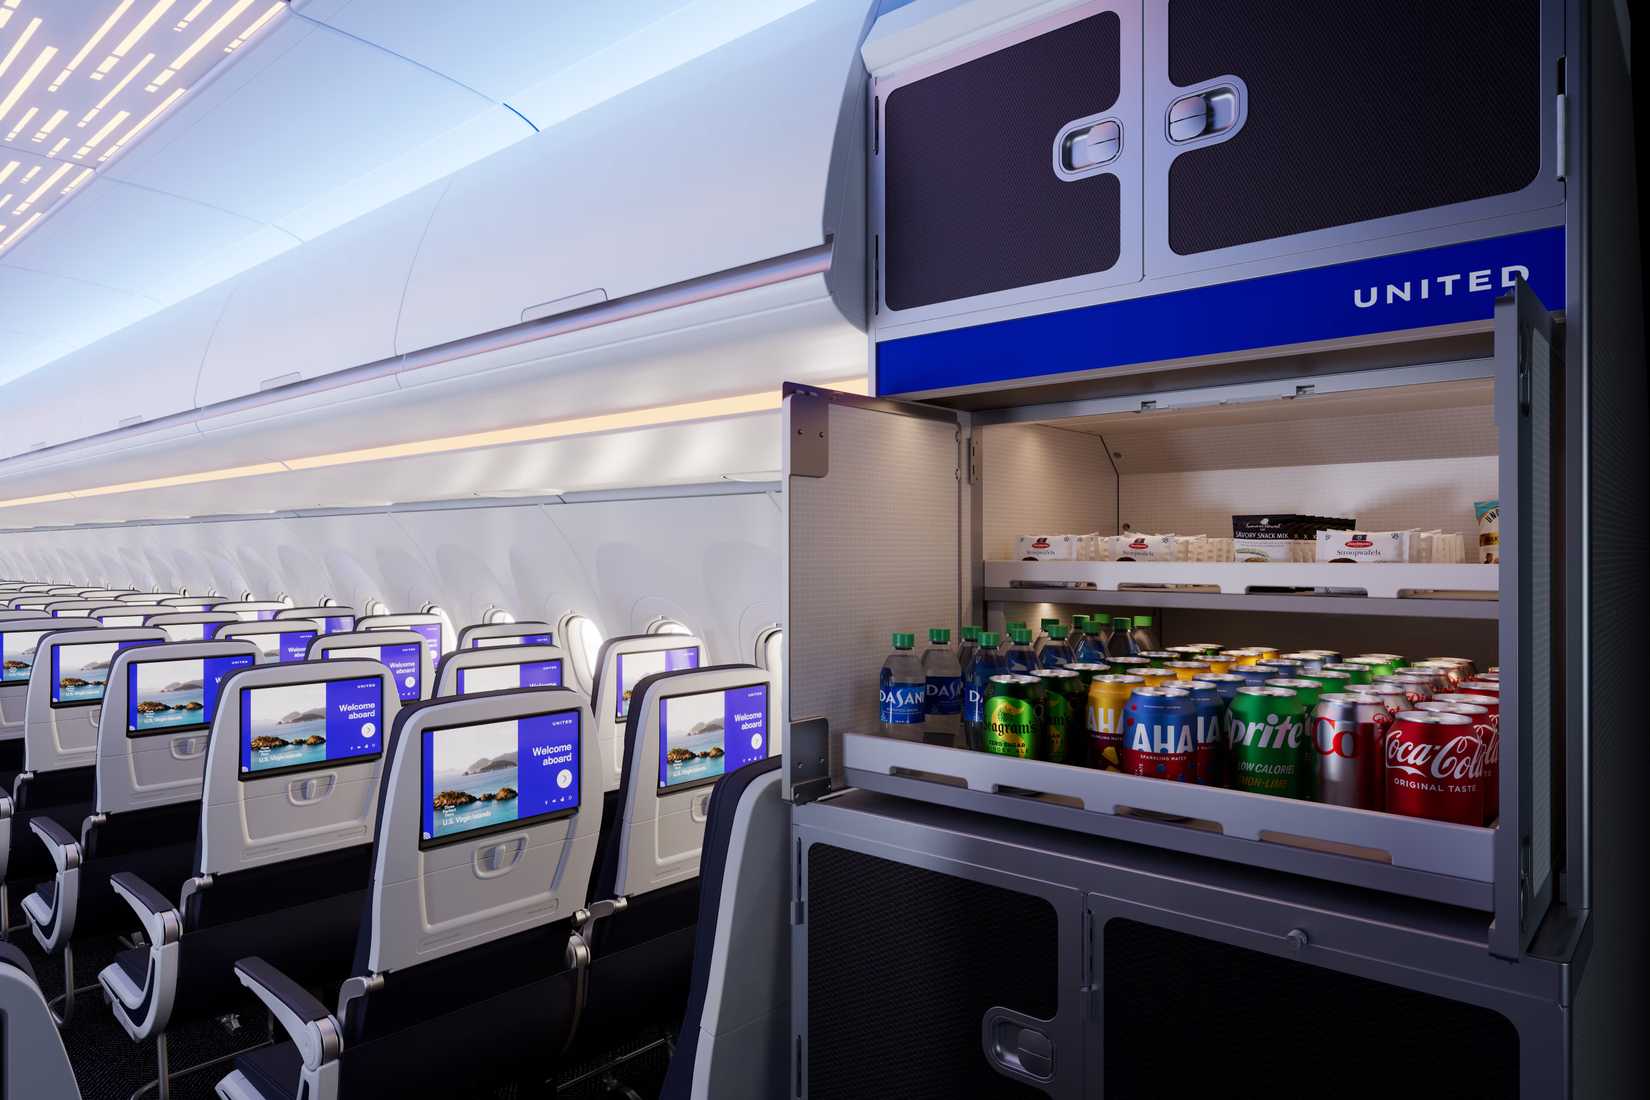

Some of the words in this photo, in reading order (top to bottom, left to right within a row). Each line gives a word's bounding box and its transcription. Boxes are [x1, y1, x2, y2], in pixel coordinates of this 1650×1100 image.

[1354, 265, 1530, 308] UNITED
[339, 702, 376, 713] Welcome
[348, 710, 376, 721] aboard
[552, 719, 573, 727] UNITED
[734, 711, 763, 723] Welcome
[741, 719, 763, 731] aboard
[1228, 713, 1304, 750] prite
[1132, 723, 1194, 754] AHA
[532, 743, 573, 758] Welcome
[542, 752, 573, 767] aboard
[1394, 777, 1445, 792] ORIGINAL
[1448, 784, 1476, 793] TASTE
